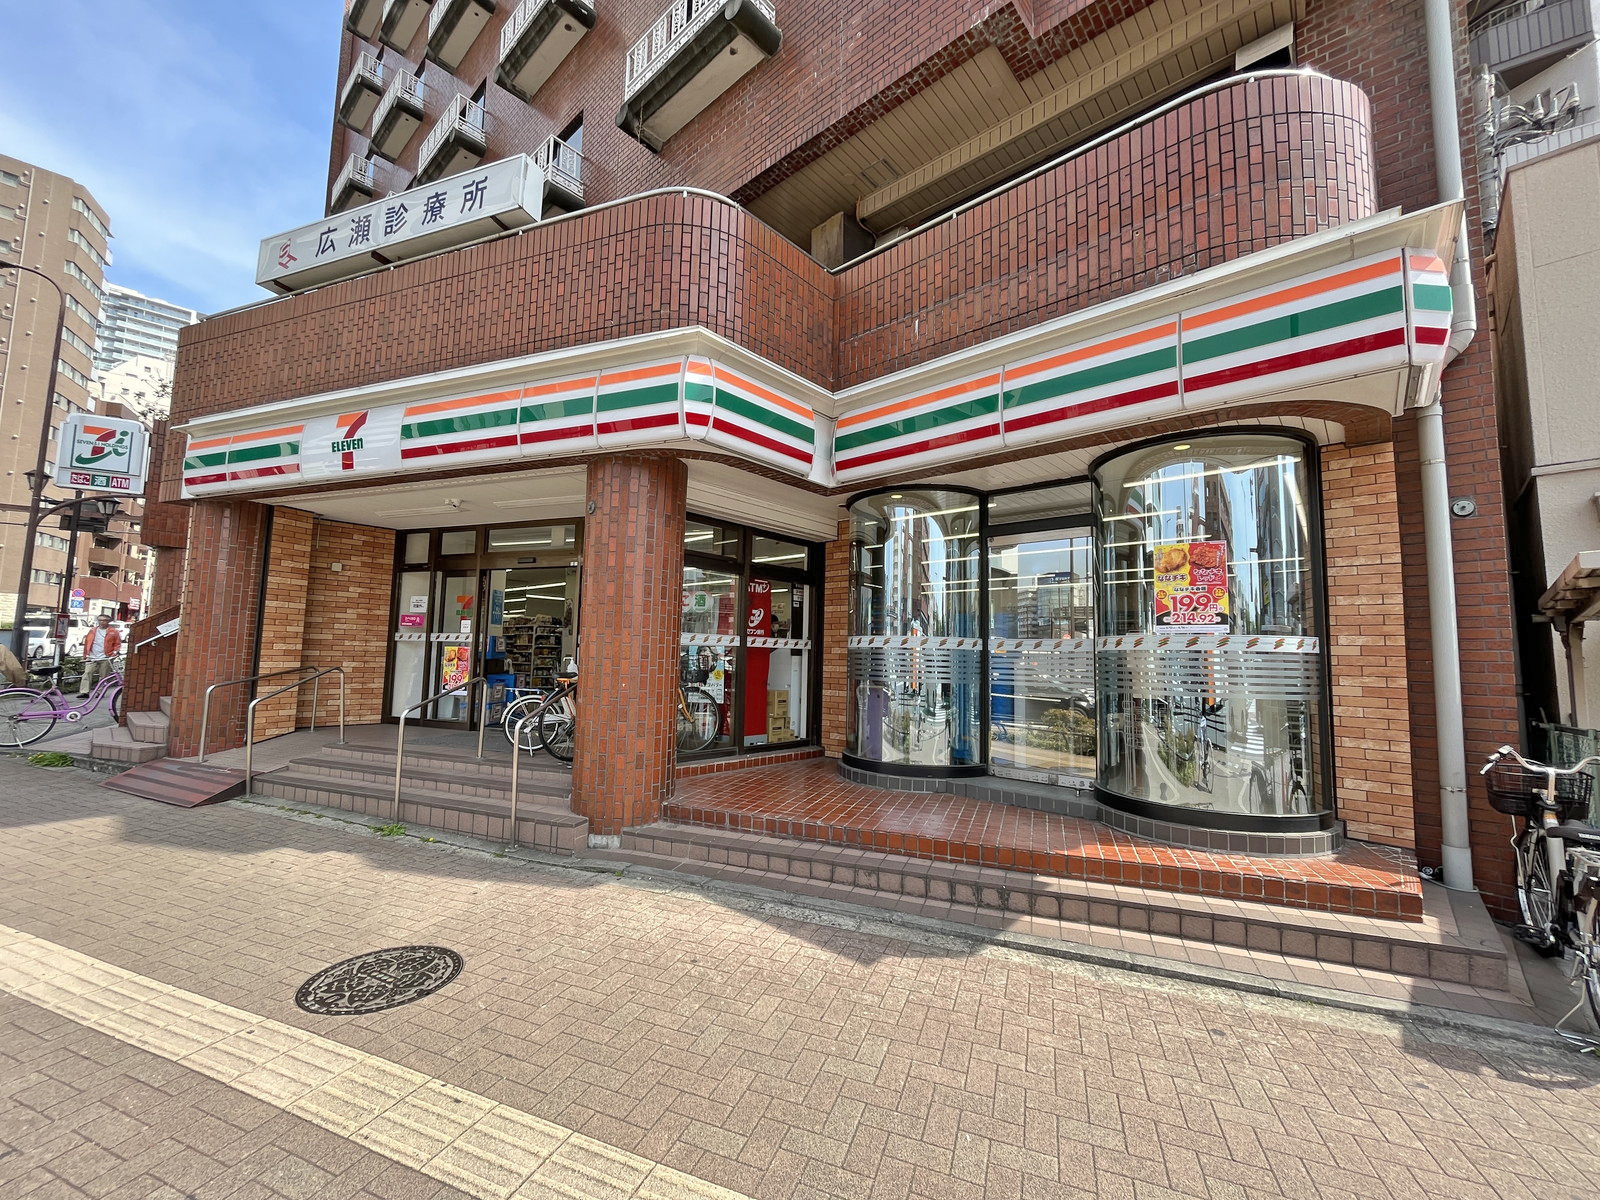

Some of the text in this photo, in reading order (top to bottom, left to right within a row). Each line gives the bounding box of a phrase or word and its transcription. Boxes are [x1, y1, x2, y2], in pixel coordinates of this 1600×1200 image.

[315, 176, 488, 258] 広瀬診療所
[71, 474, 90, 484] たばこ
[94, 476, 107, 486] 酒
[111, 477, 129, 488] ATM
[1157, 574, 1187, 582] ななチキ
[694, 594, 706, 607] 酒
